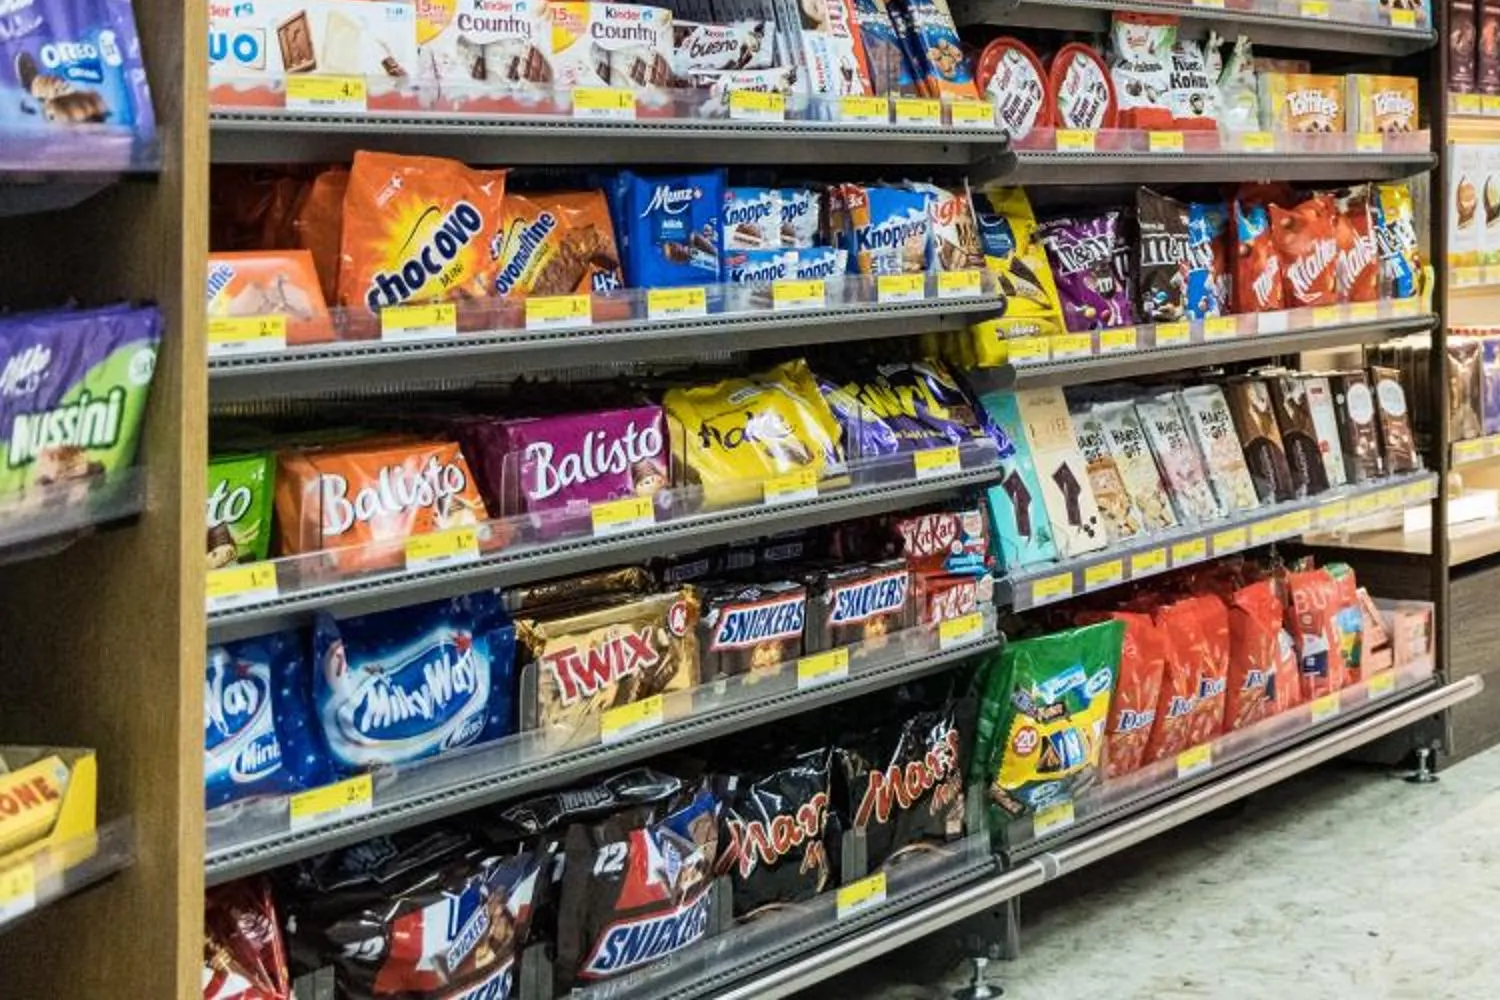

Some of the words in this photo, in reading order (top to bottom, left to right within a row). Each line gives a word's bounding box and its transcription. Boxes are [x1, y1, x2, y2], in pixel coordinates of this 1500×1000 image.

[457, 14, 532, 39] Country
[591, 21, 658, 45] Country
[690, 30, 738, 59] bueno
[856, 220, 928, 250] Knoppers
[524, 419, 665, 500] Balisto
[320, 454, 466, 537] Balisto
[832, 573, 908, 623] SNICKERS
[719, 600, 804, 645] SNICKERS
[854, 729, 959, 836] Mars
[714, 792, 828, 880] Mar
[593, 841, 629, 877] 12
